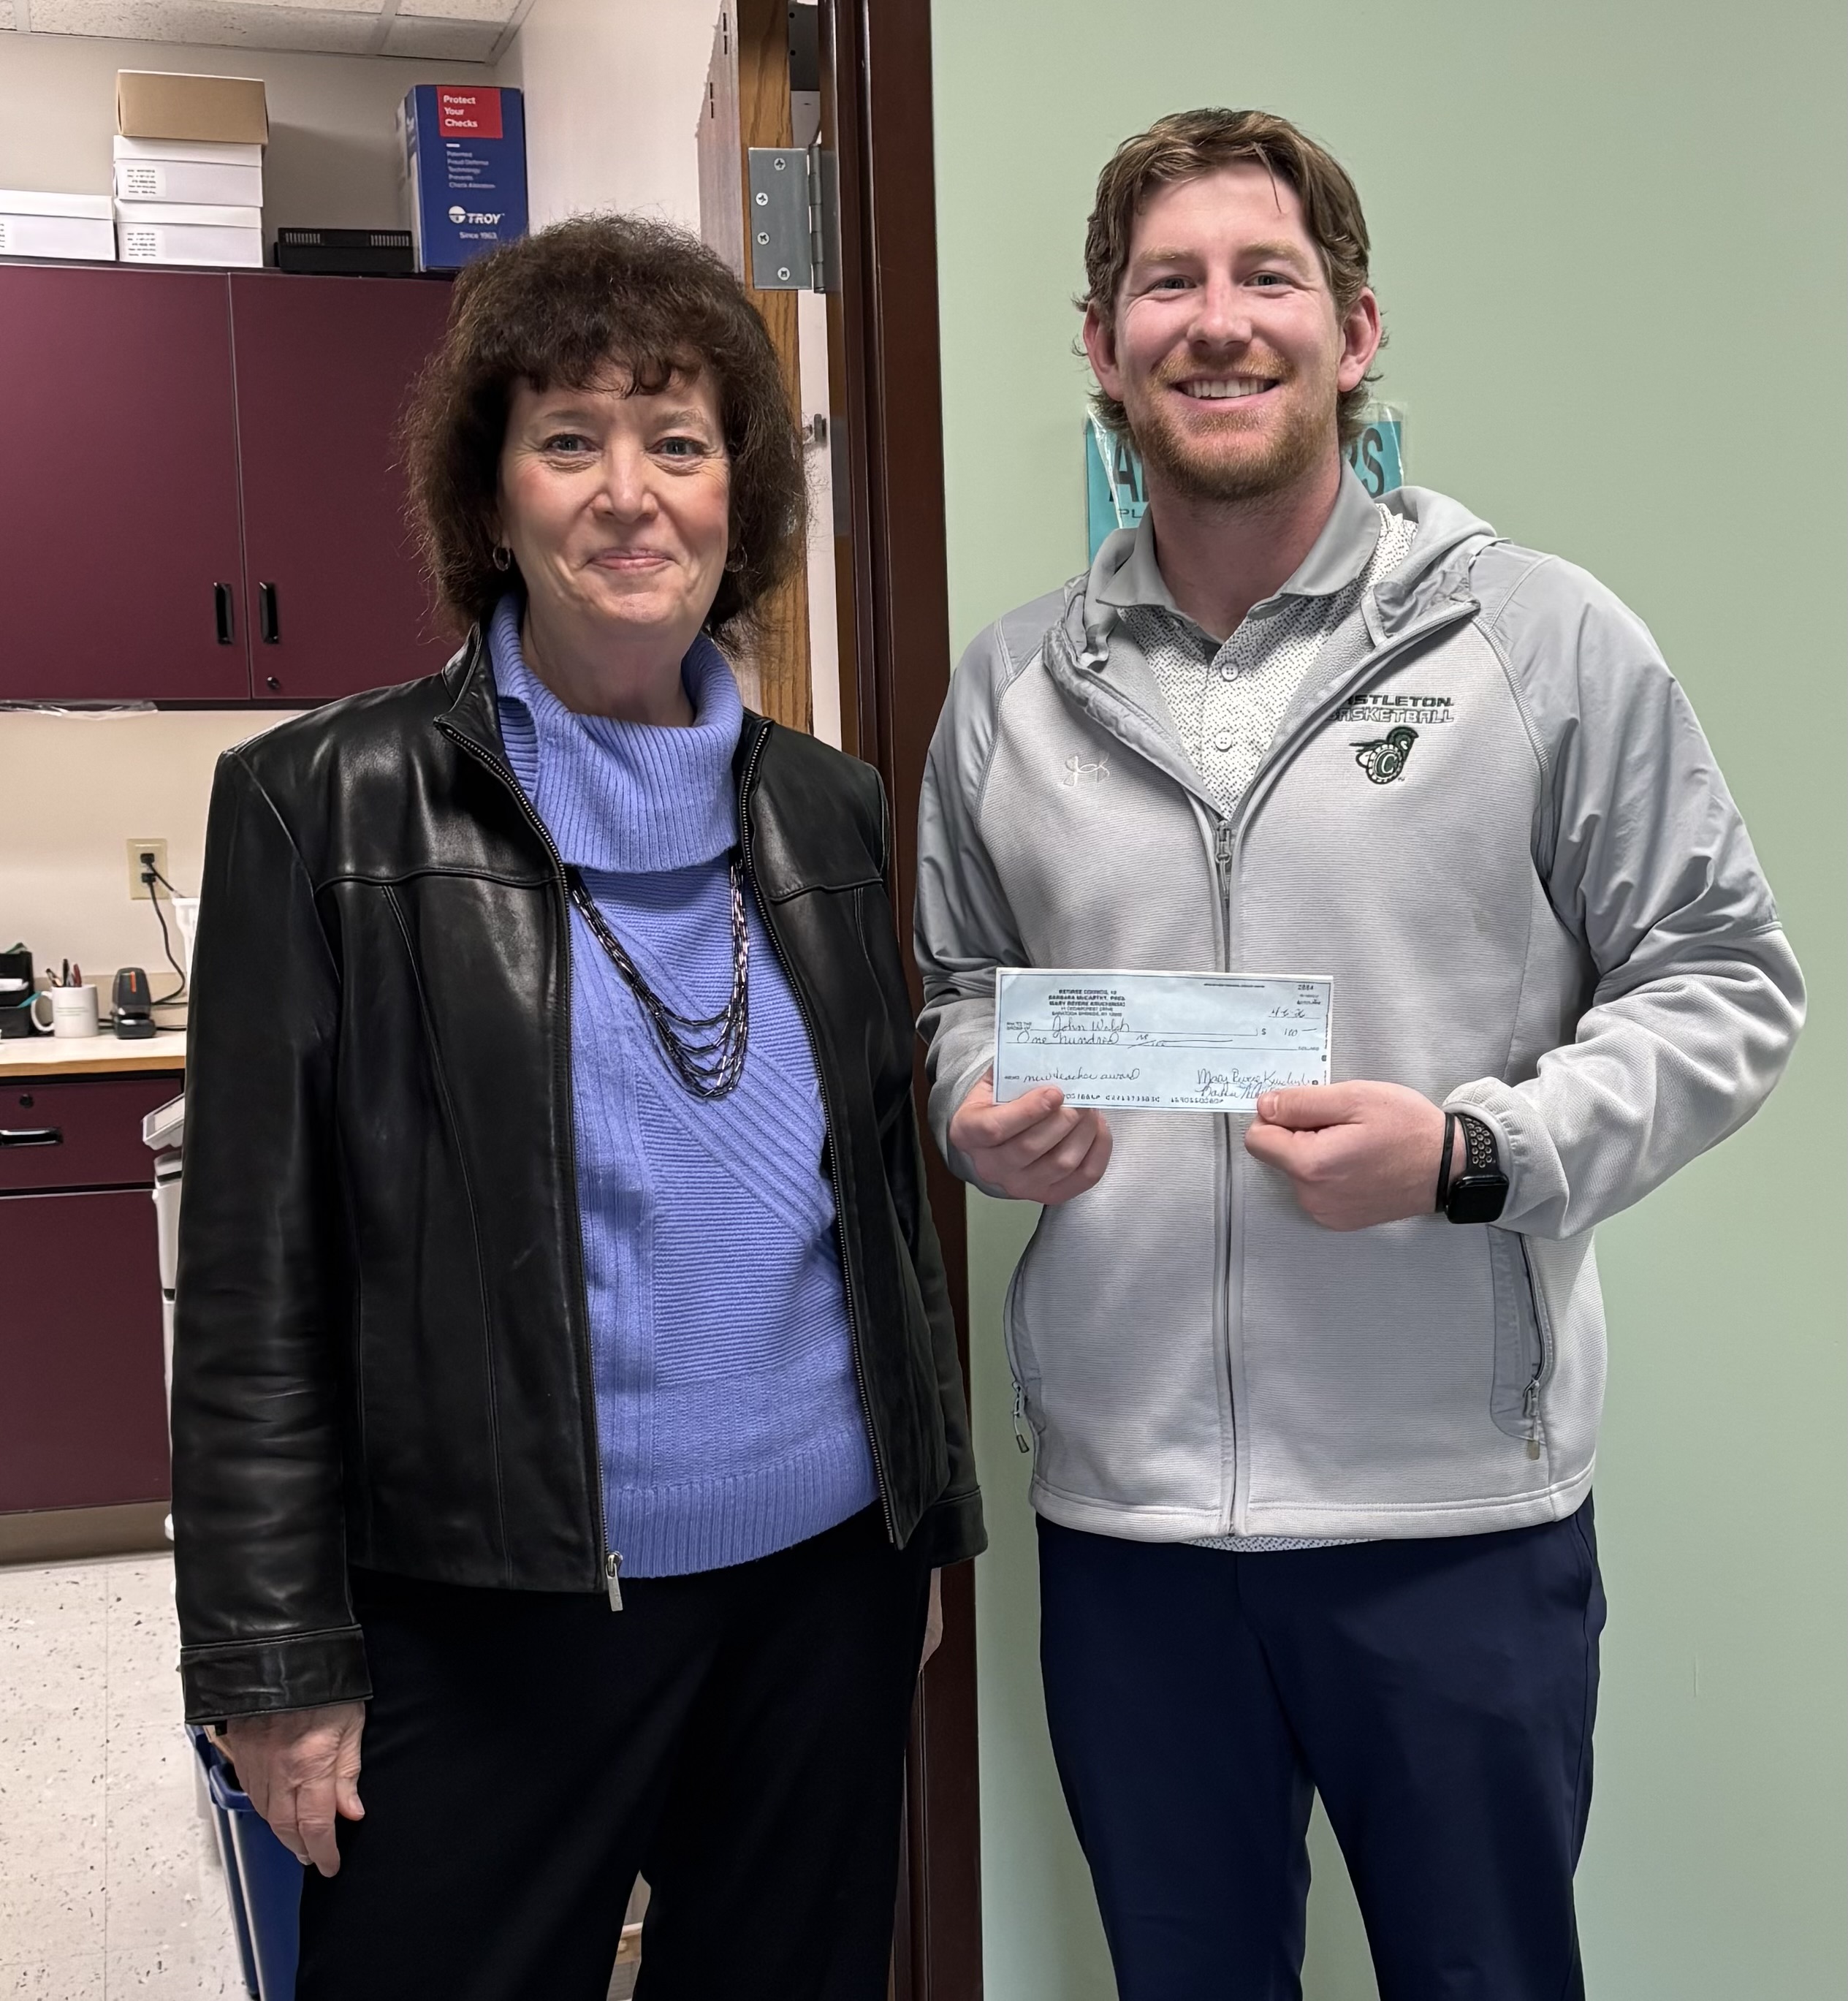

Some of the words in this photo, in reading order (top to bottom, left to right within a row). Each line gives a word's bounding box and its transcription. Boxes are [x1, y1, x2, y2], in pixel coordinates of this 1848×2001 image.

[444, 95, 476, 105] Protect
[444, 107, 464, 115] Your
[445, 118, 478, 128] Checks
[466, 213, 501, 224] TROY
[480, 232, 497, 240] 1963
[1052, 1015, 1087, 1038] John
[1017, 1029, 1047, 1044] One
[1060, 1032, 1119, 1045] hundred
